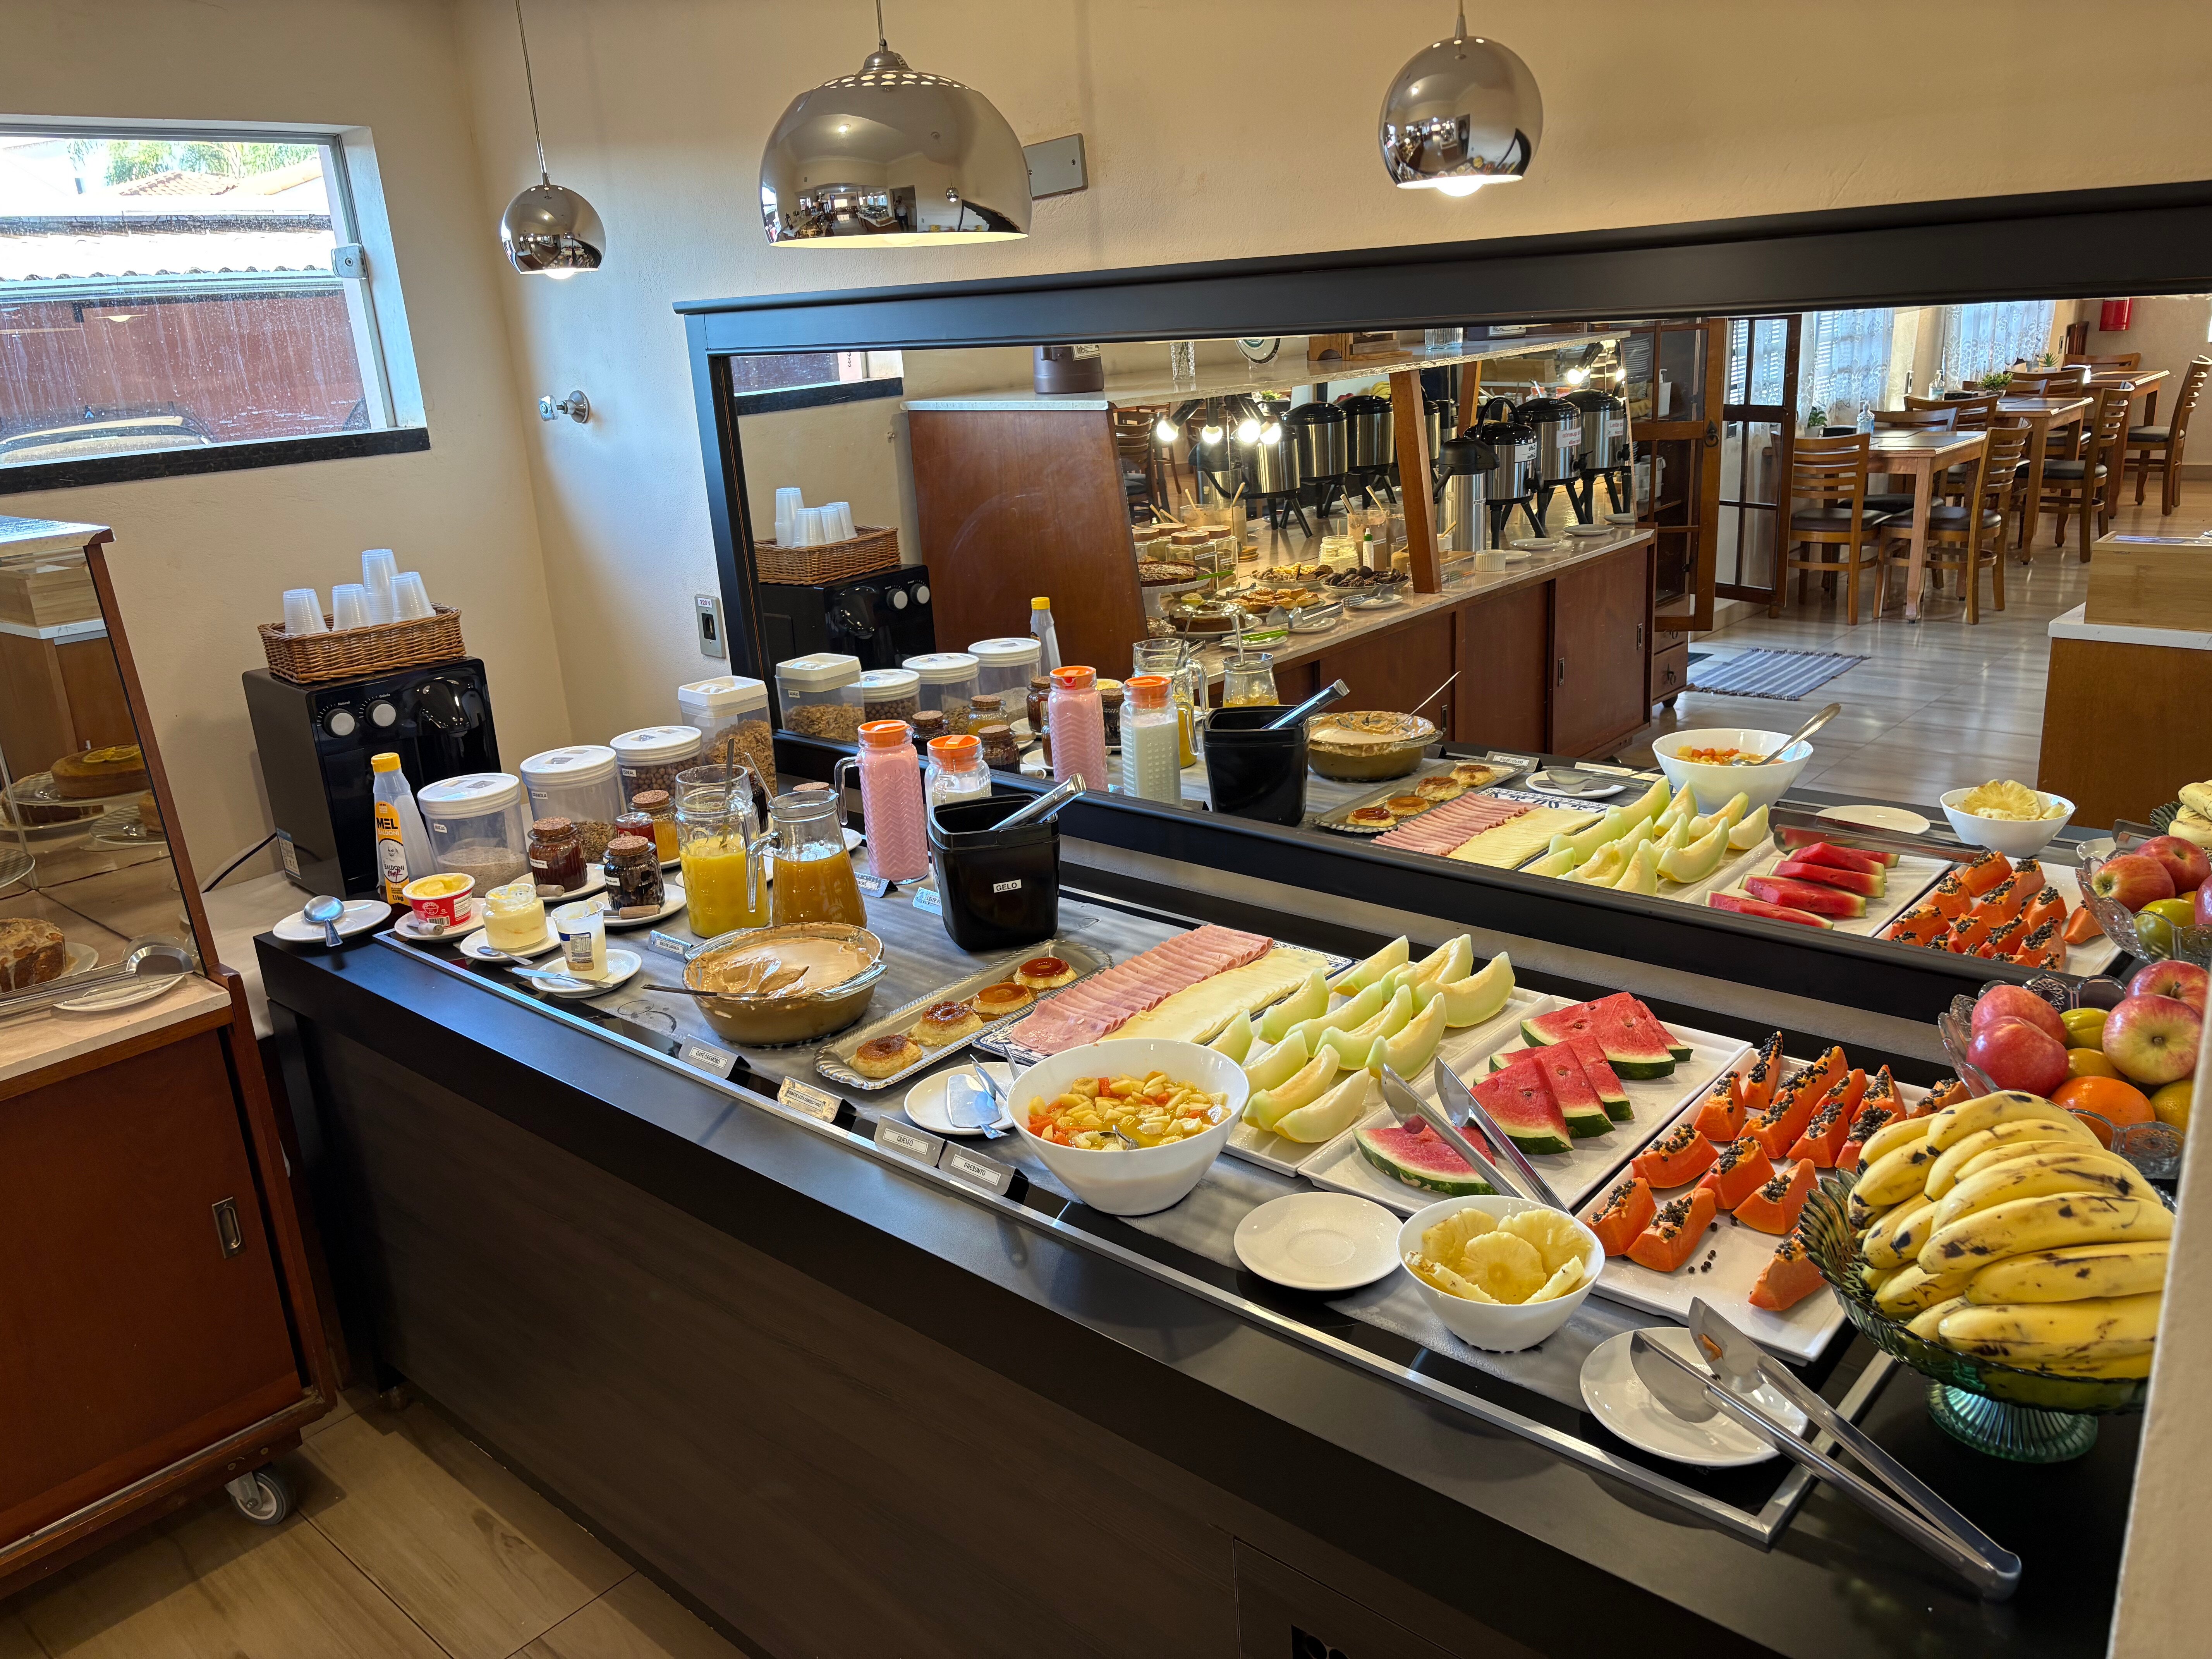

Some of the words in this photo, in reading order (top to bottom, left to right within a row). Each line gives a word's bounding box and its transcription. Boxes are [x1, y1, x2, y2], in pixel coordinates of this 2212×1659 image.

[376, 817, 398, 830] MEL
[996, 882, 1017, 891] GELO
[704, 1054, 720, 1064] CREMOSO
[897, 1135, 913, 1146] QUEIJO
[964, 1162, 986, 1176] PRESUNTO
